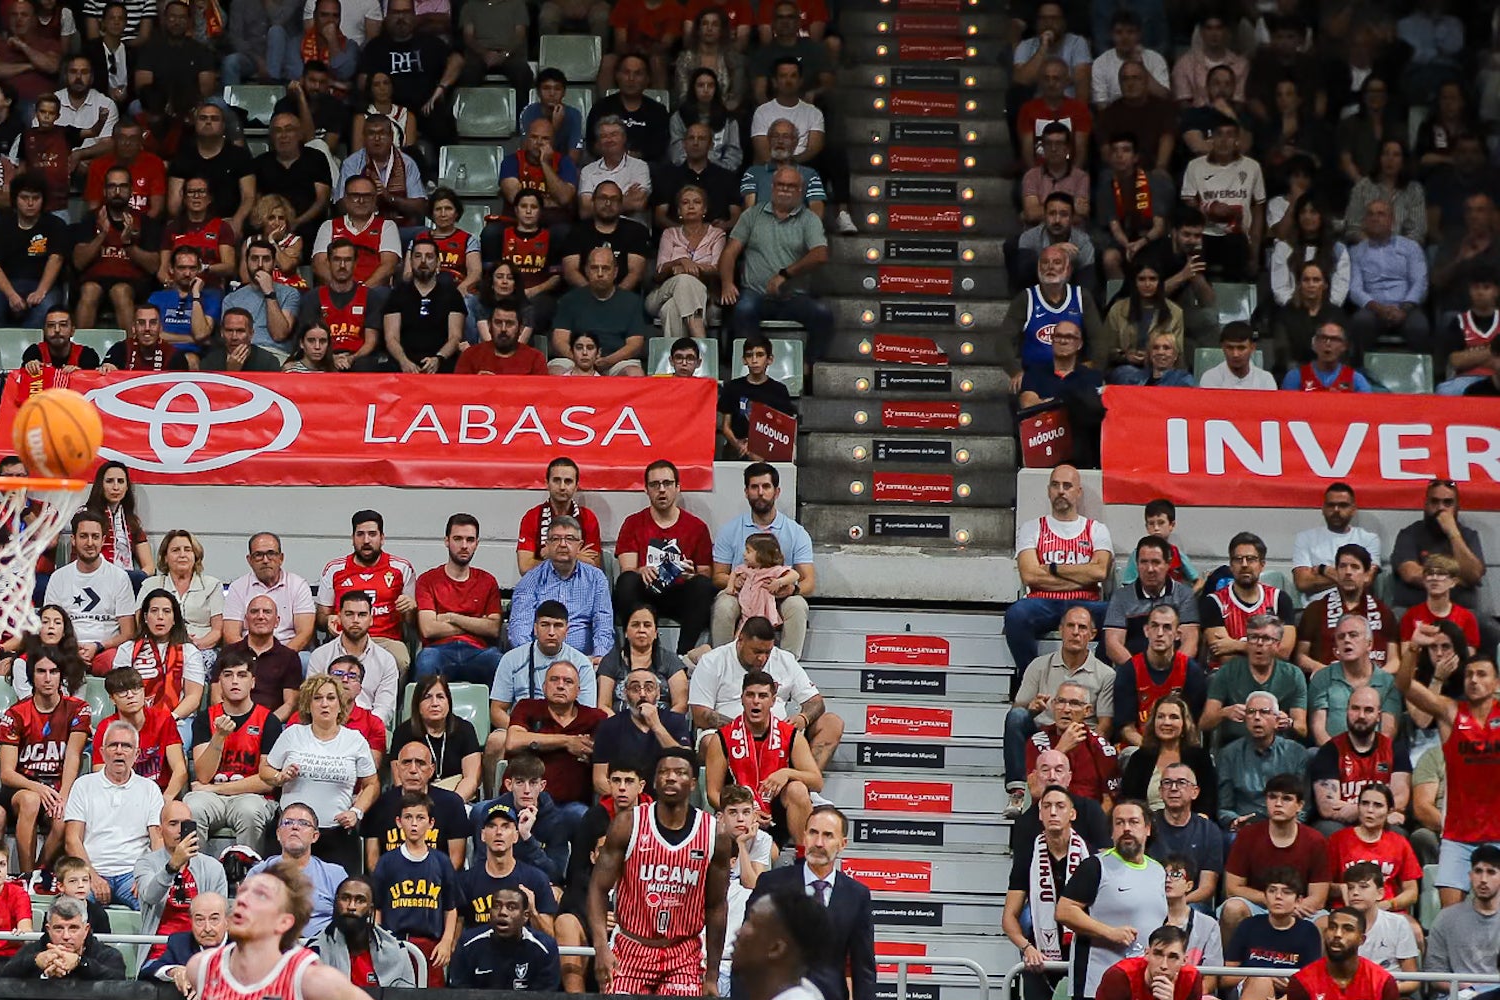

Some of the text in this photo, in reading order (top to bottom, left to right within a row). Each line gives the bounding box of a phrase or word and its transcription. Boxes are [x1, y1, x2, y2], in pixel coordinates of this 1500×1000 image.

[363, 403, 652, 448] LABASA
[755, 421, 790, 445] MÓDULO
[1028, 426, 1066, 449] MÓDULO
[1166, 417, 1500, 481] INVER
[1041, 550, 1091, 565] UCAM
[879, 645, 947, 654] ESTRELLA LEVANTE
[879, 718, 950, 728] ESTRELLA LEVANTE
[19, 741, 66, 763] UCA
[878, 792, 950, 802] ESTRELLA LEVANTE
[639, 863, 700, 887] UCAM
[855, 869, 929, 880] ESTRELLA LEVANTE
[389, 879, 442, 900] UCAM
[648, 881, 687, 895] MURCIA
[658, 909, 670, 932] 0
[872, 908, 907, 917] yuntamiento
